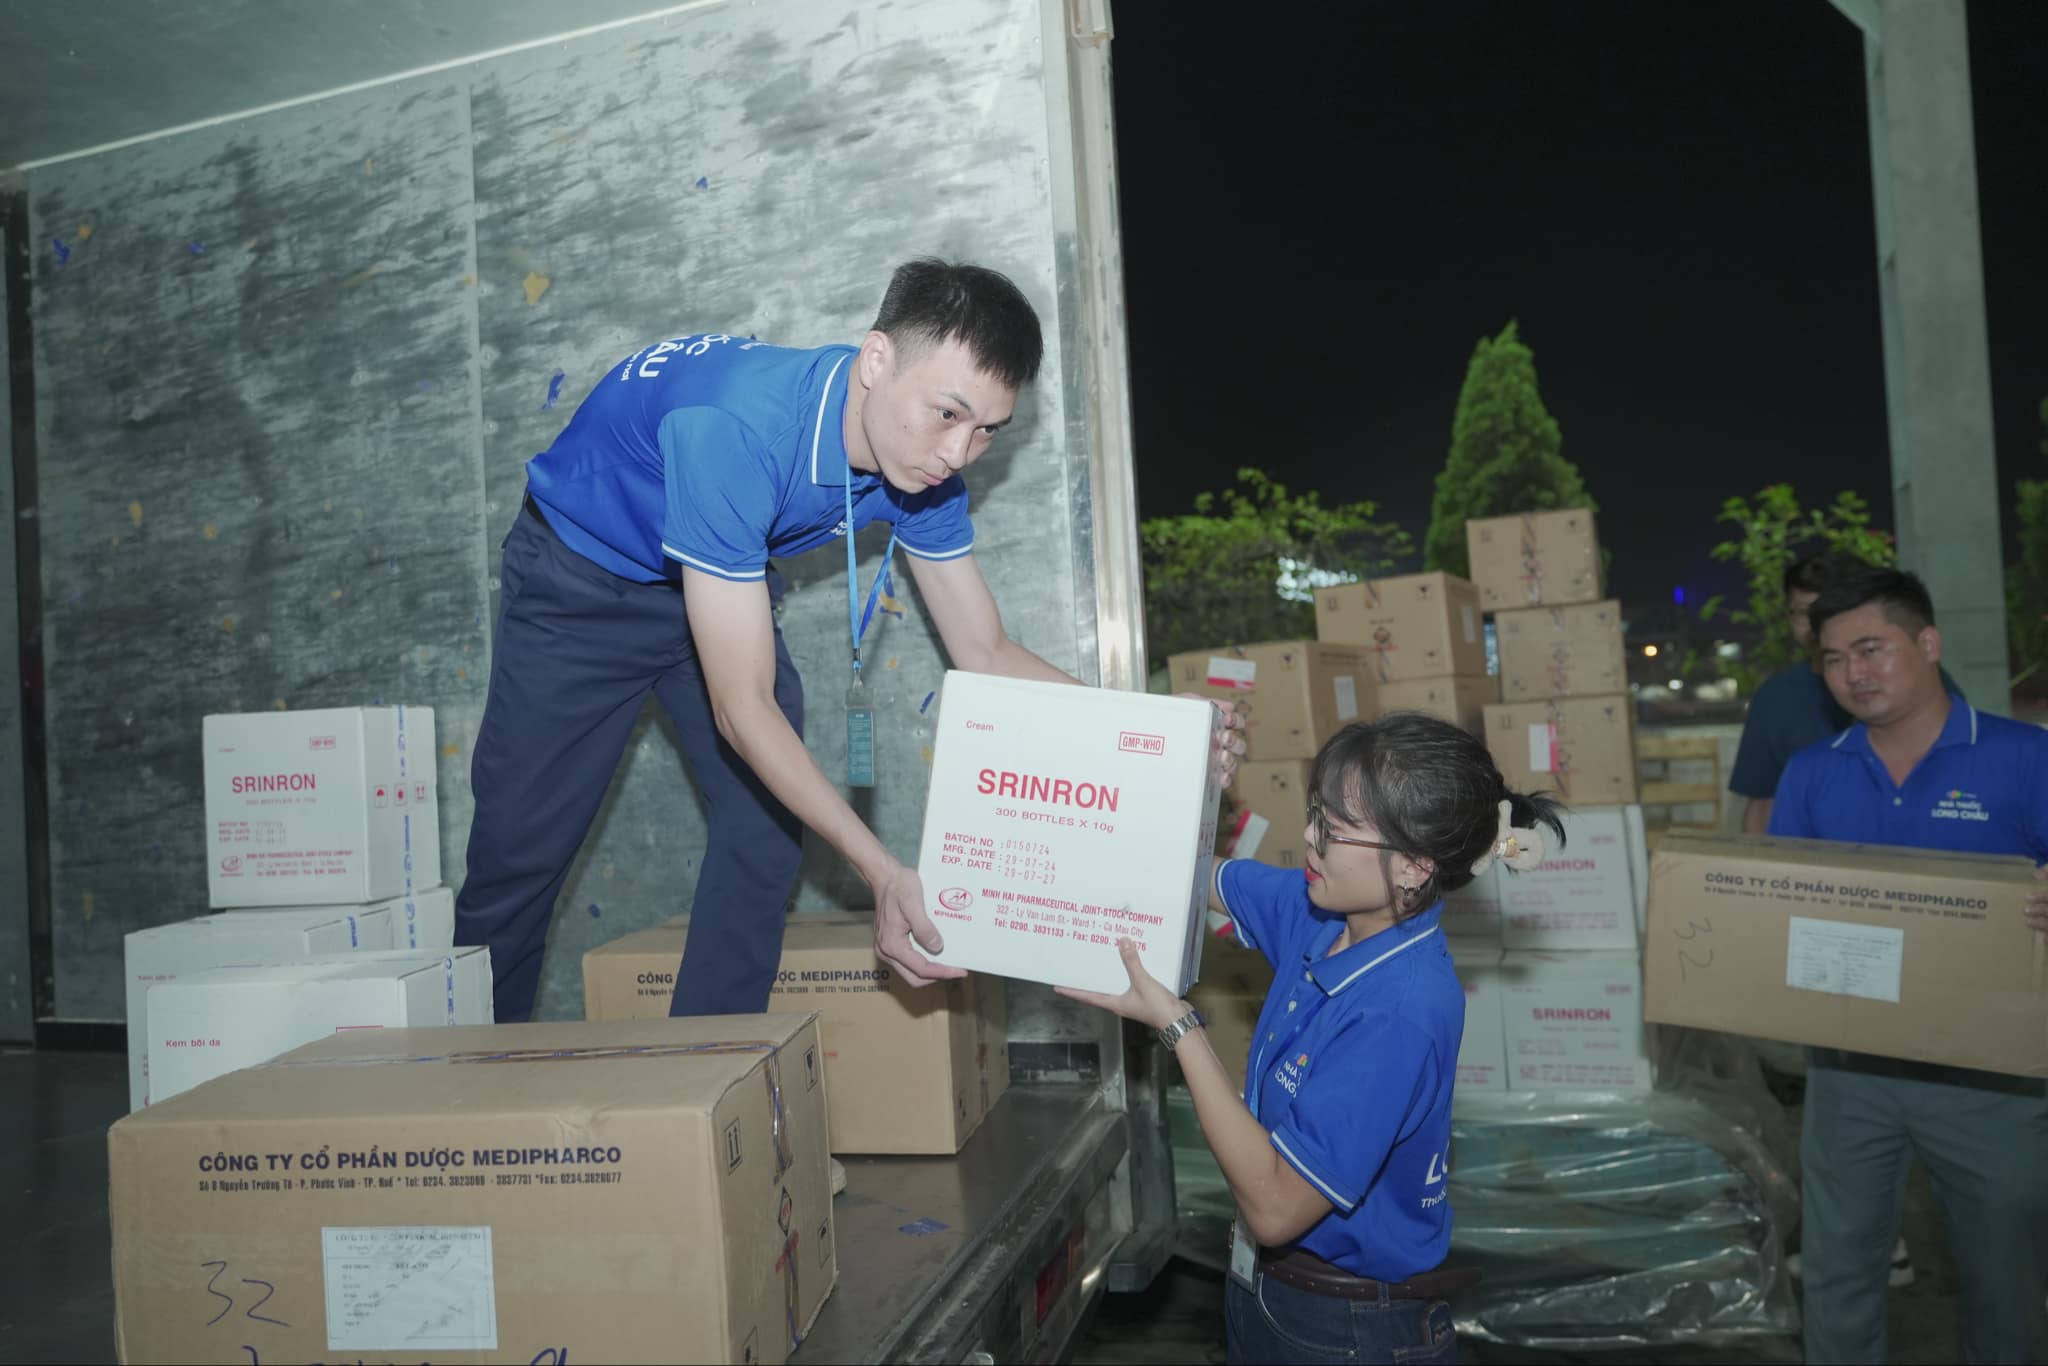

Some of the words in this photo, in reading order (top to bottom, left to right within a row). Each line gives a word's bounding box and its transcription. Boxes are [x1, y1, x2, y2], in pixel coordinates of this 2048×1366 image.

[966, 720, 995, 732] Cream
[1122, 735, 1161, 752] GMP-WHO
[231, 773, 317, 794] SRINRON
[977, 768, 1120, 812] SRINRON
[995, 807, 1017, 818] 300
[1021, 811, 1075, 826] BOTTLES
[1093, 821, 1114, 833] 10g
[944, 832, 976, 845] BATCH
[979, 838, 994, 847] NO
[943, 843, 967, 855] MFG.
[970, 848, 996, 859] DATE
[941, 855, 963, 866] EXP.
[967, 859, 993, 871] DATE
[1704, 872, 1744, 886] CÔNG
[1748, 877, 1766, 888] TY
[1885, 889, 1988, 910] MEDIPHARCO
[982, 888, 1000, 899] MINH
[1002, 891, 1016, 902] HAI
[1016, 893, 1079, 913] PHARMACEUTICAL
[1080, 904, 1126, 920] JOINT-STOCK
[1128, 911, 1164, 927] COMPANY
[994, 918, 1008, 929] Tel:
[1072, 930, 1088, 942] Fax:
[995, 904, 1009, 915] 322
[1072, 916, 1090, 929] Ward
[1131, 925, 1145, 938] City
[637, 971, 673, 984] CÔNG
[800, 970, 890, 982] MEDIPHARCO
[1532, 1008, 1612, 1021] SRINRON
[166, 1039, 187, 1048] Kem
[199, 1151, 259, 1172] CÔNG
[265, 1153, 294, 1171] TY
[300, 1144, 331, 1170] CỔ
[404, 1147, 465, 1172] DƯỢC
[472, 1146, 622, 1167] MEDIPHARCO
[201, 1260, 293, 1328] 32
